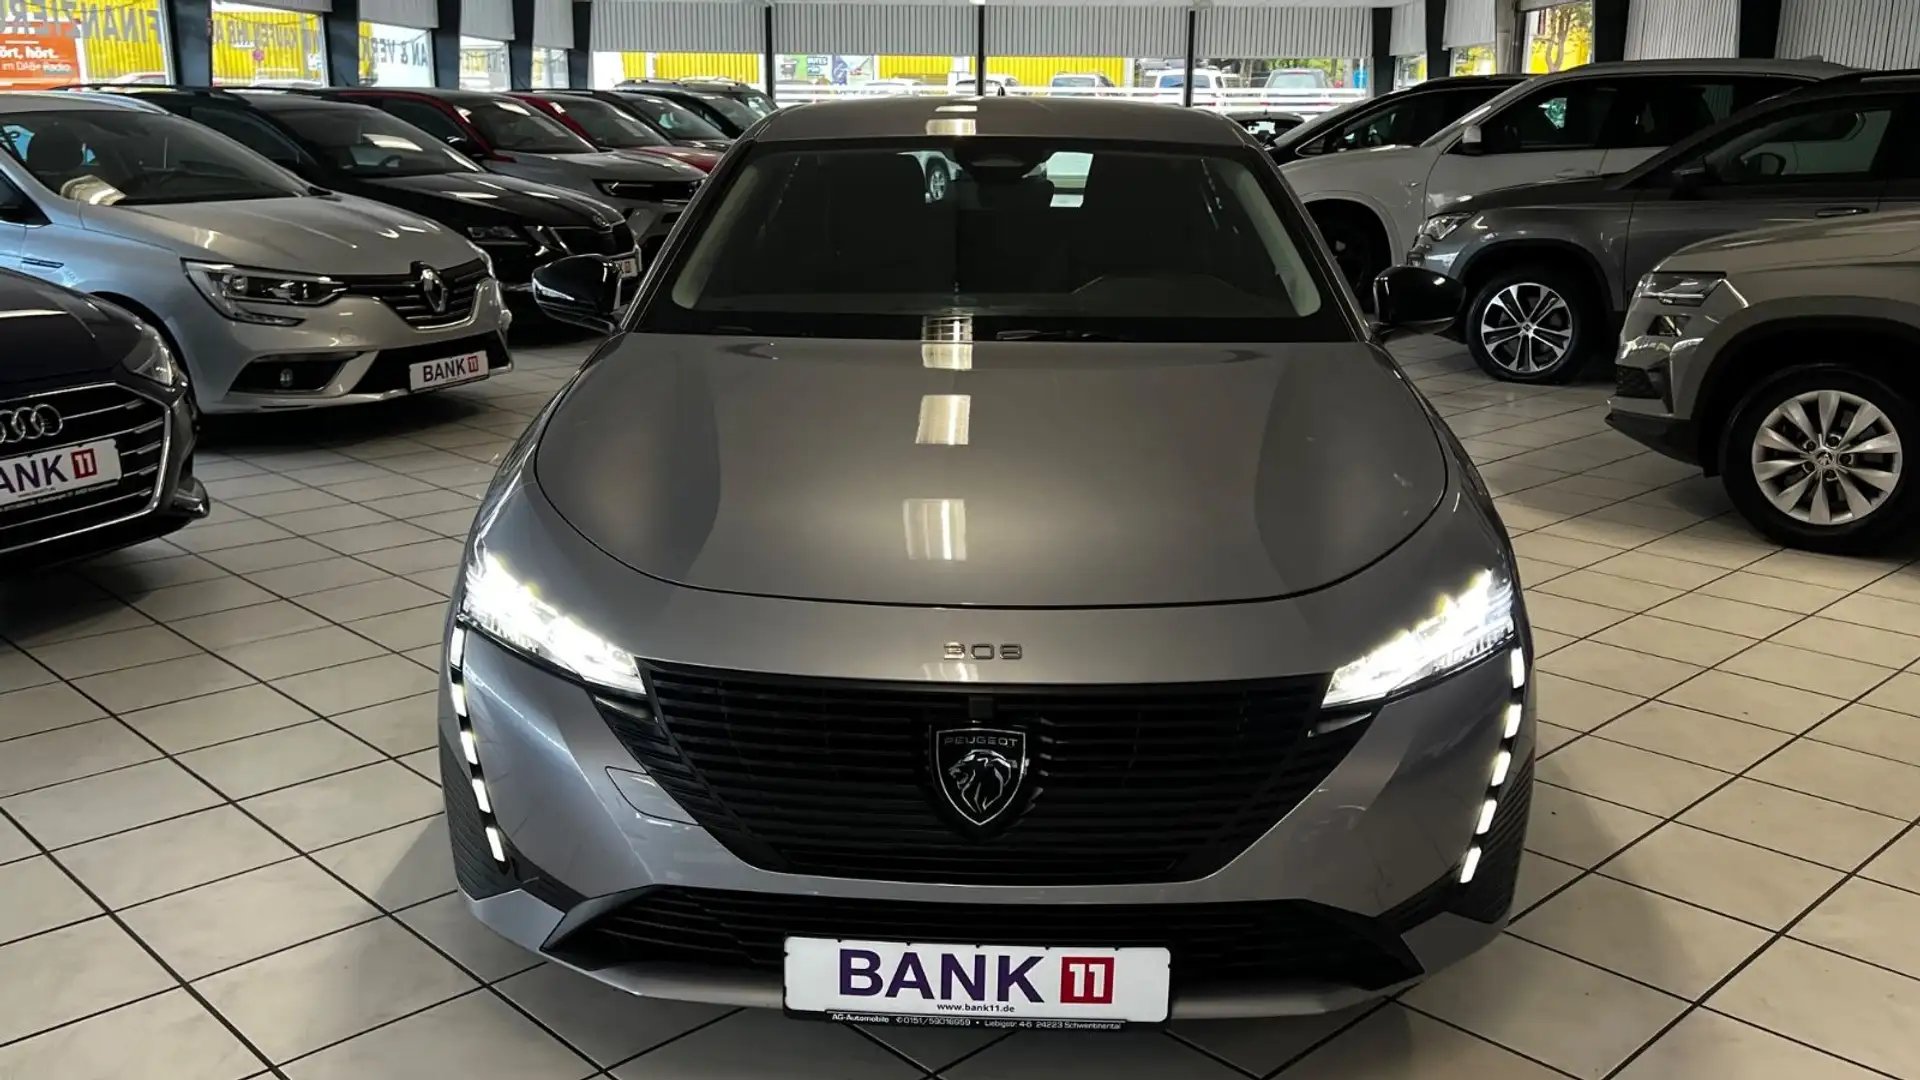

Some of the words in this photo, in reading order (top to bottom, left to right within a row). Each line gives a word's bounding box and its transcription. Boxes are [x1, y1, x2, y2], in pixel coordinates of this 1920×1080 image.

[423, 358, 467, 383] BANK
[73, 450, 96, 478] 11
[943, 642, 1023, 660] 308
[944, 735, 1019, 747] PEUGEOT
[838, 948, 1045, 1004] BANK
[1065, 960, 1109, 1002] 11
[937, 1002, 1016, 1014] www.bank11.de
